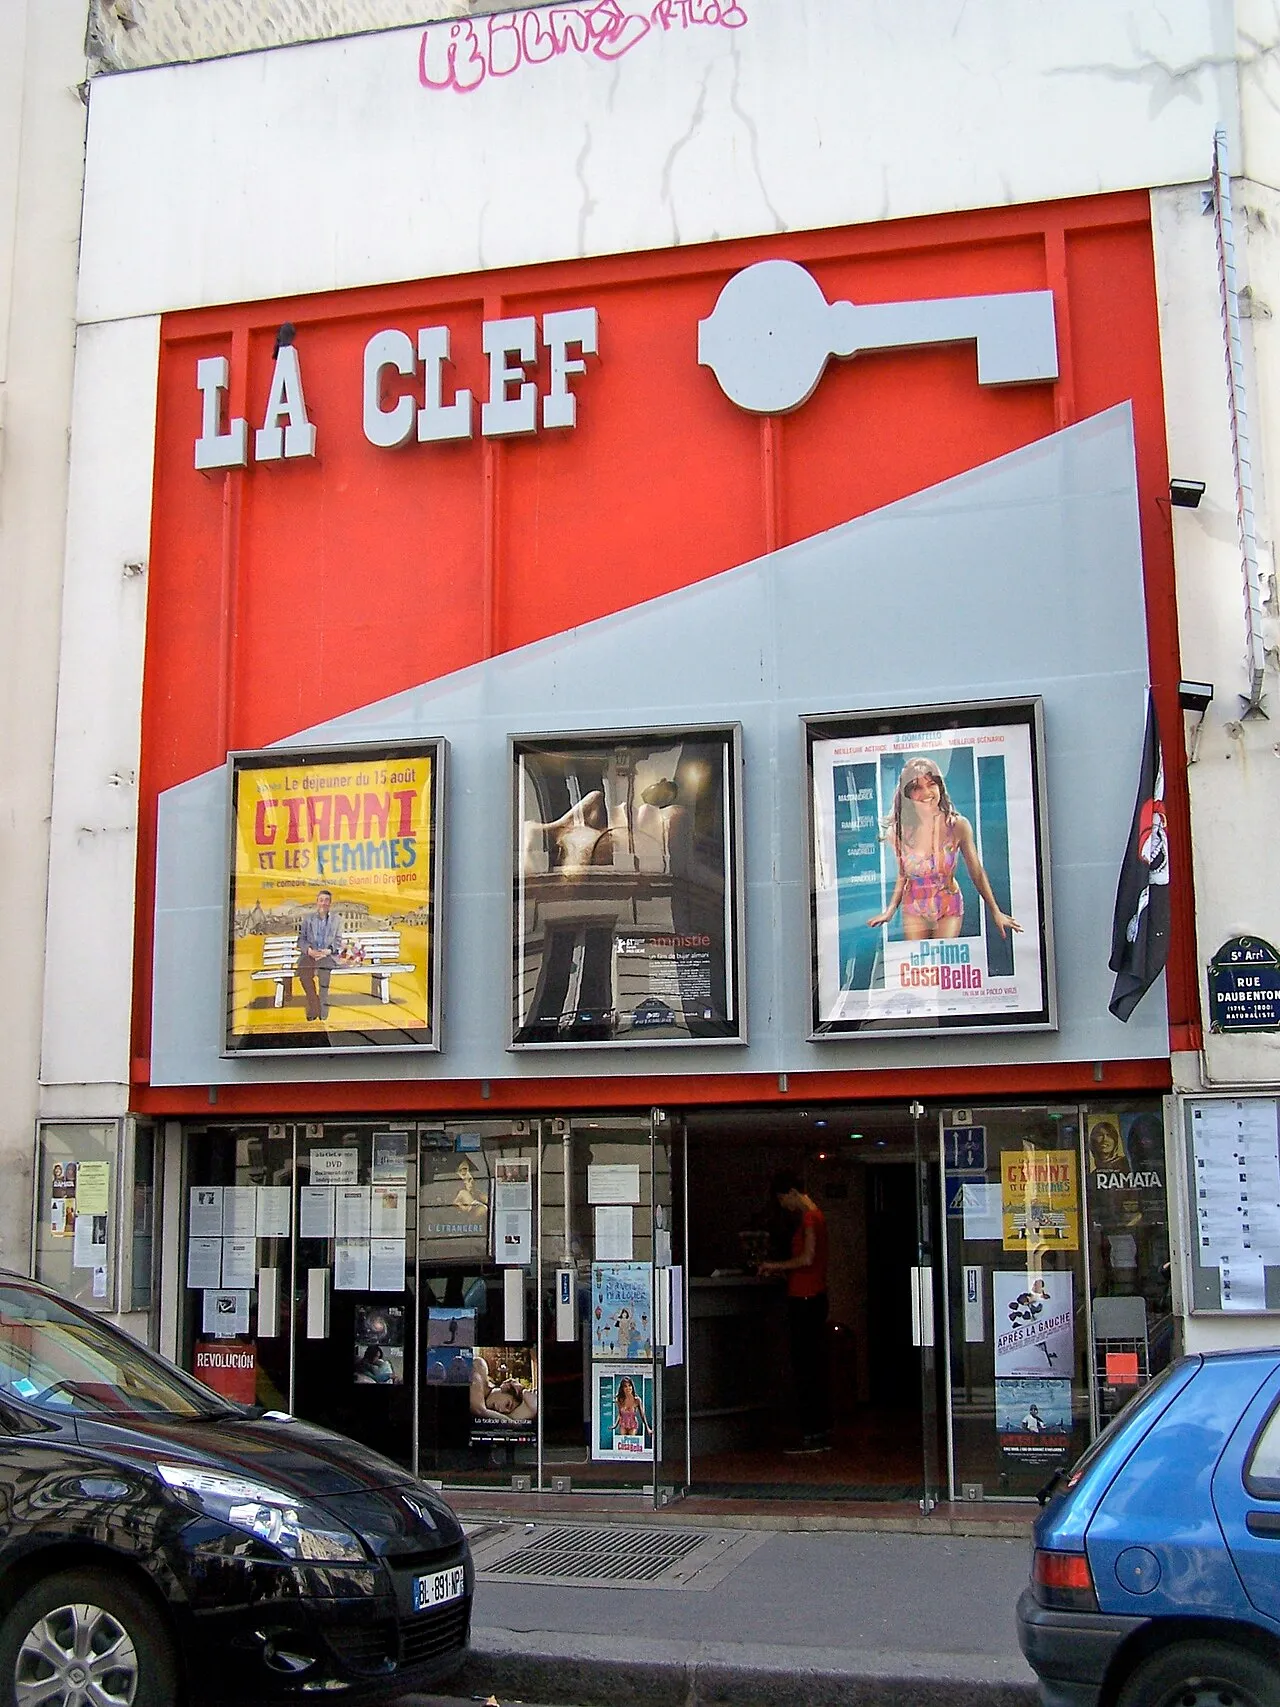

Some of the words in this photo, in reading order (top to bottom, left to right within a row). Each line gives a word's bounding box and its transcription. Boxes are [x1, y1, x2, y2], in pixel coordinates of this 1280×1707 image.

[195, 346, 316, 470] LA
[363, 307, 600, 448] CLEF
[285, 776, 298, 791] Le
[356, 772, 369, 786] du
[374, 769, 387, 784] 15
[390, 769, 416, 784] août
[255, 789, 418, 845] GIANNI
[258, 850, 276, 870] ET
[284, 849, 311, 869] LES
[317, 838, 417, 874] FEMMES
[382, 872, 417, 886] Gregorio
[650, 933, 711, 947] amnistie
[920, 940, 970, 966] Prima
[900, 962, 940, 987] Cosa
[940, 964, 982, 990] Bella
[1237, 977, 1260, 987] RUE
[1217, 990, 1280, 1002] DAUBENTON
[1096, 1171, 1163, 1189] RAMATA
[1026, 1325, 1036, 1337] LA
[1038, 1311, 1071, 1331] GAUCHE
[197, 1351, 254, 1369] REVOLUCIÓN
